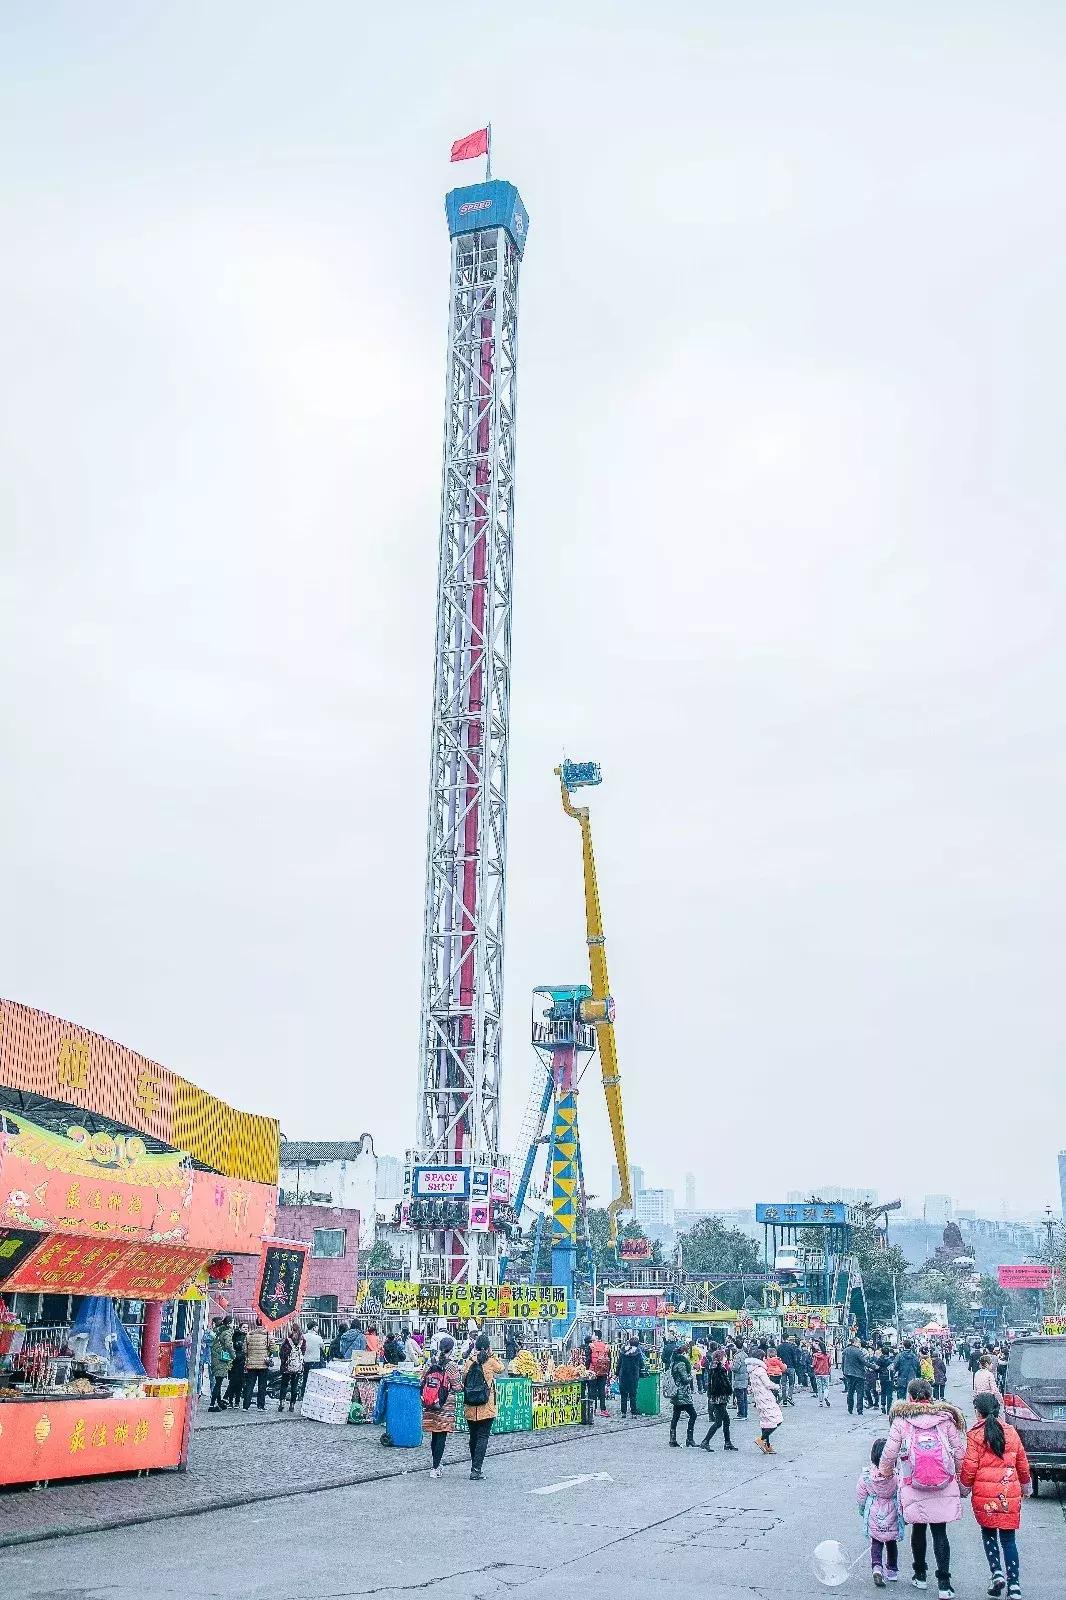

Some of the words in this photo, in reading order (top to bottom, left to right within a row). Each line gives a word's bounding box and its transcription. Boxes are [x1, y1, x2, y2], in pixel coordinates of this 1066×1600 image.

[459, 200, 492, 214] SPEED
[424, 1173, 458, 1182] SPACE
[427, 1183, 455, 1192] SHOT
[441, 1286, 497, 1301] 特色烤肉
[512, 1286, 565, 1303] 铁板鸭肠
[614, 1300, 650, 1312] 售票处
